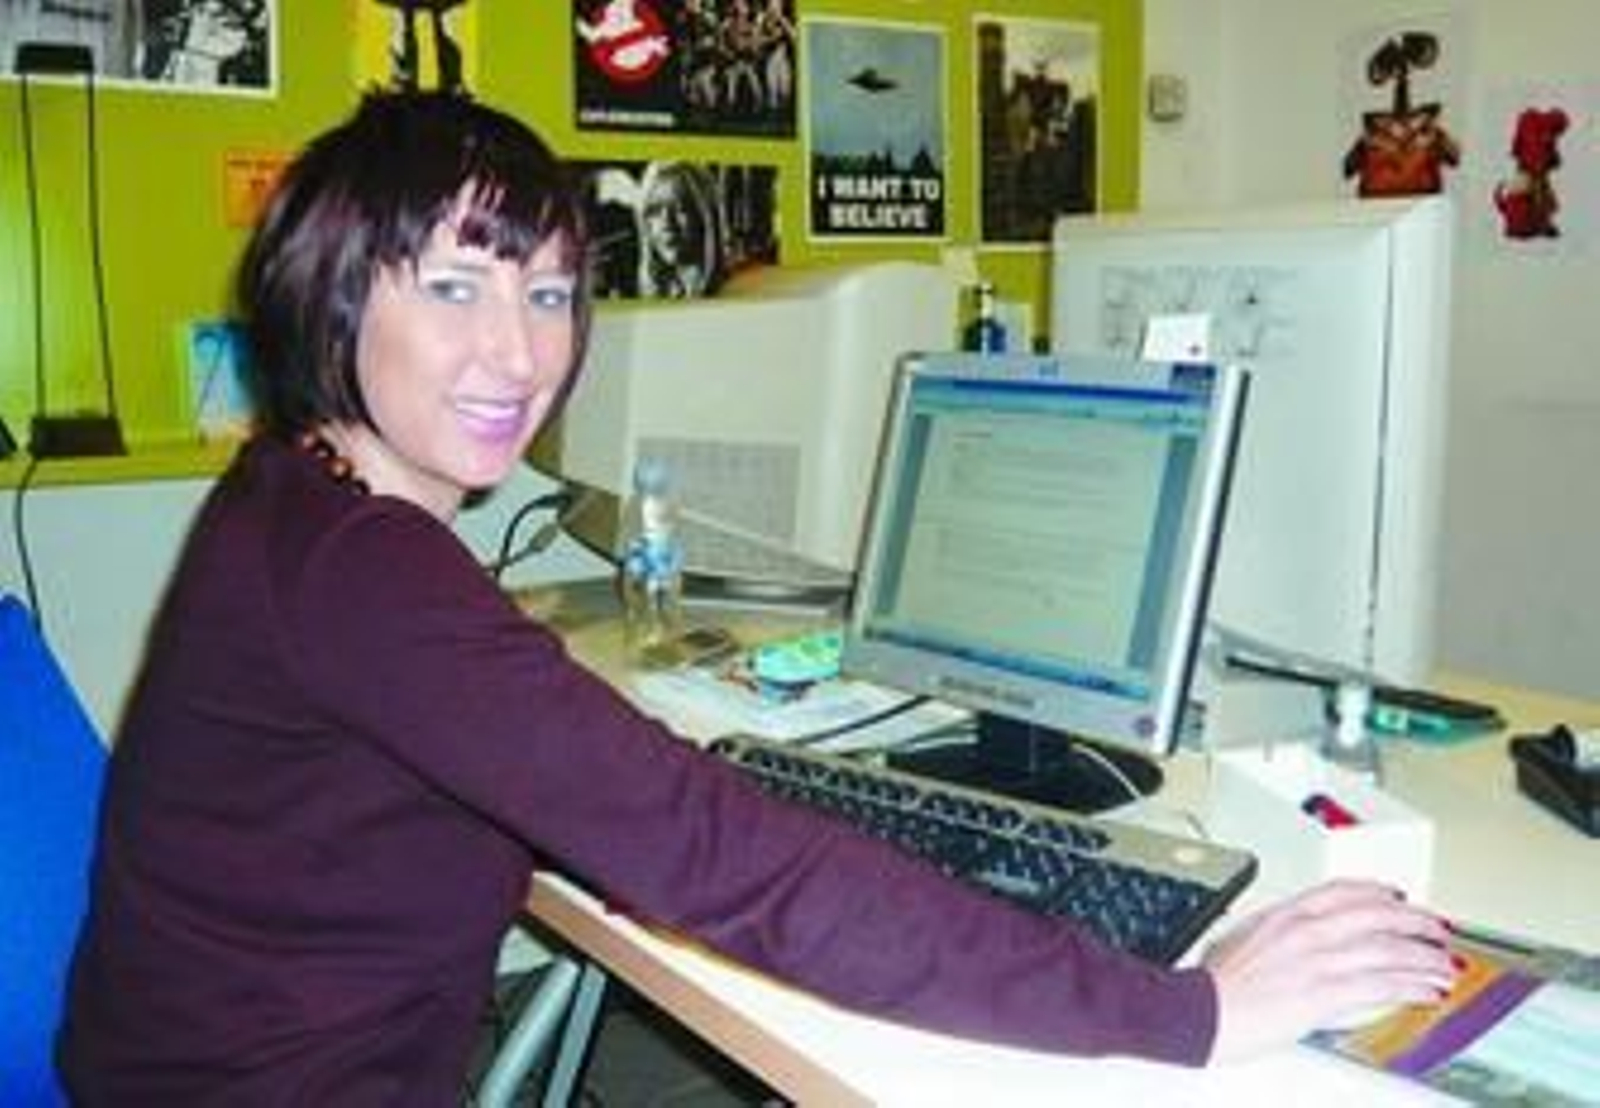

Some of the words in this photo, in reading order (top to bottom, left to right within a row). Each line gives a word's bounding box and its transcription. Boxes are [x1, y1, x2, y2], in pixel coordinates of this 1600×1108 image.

[818, 175, 826, 199] I
[832, 176, 902, 199] WANT
[911, 177, 940, 200] TO
[829, 204, 928, 228] BELIEVE
